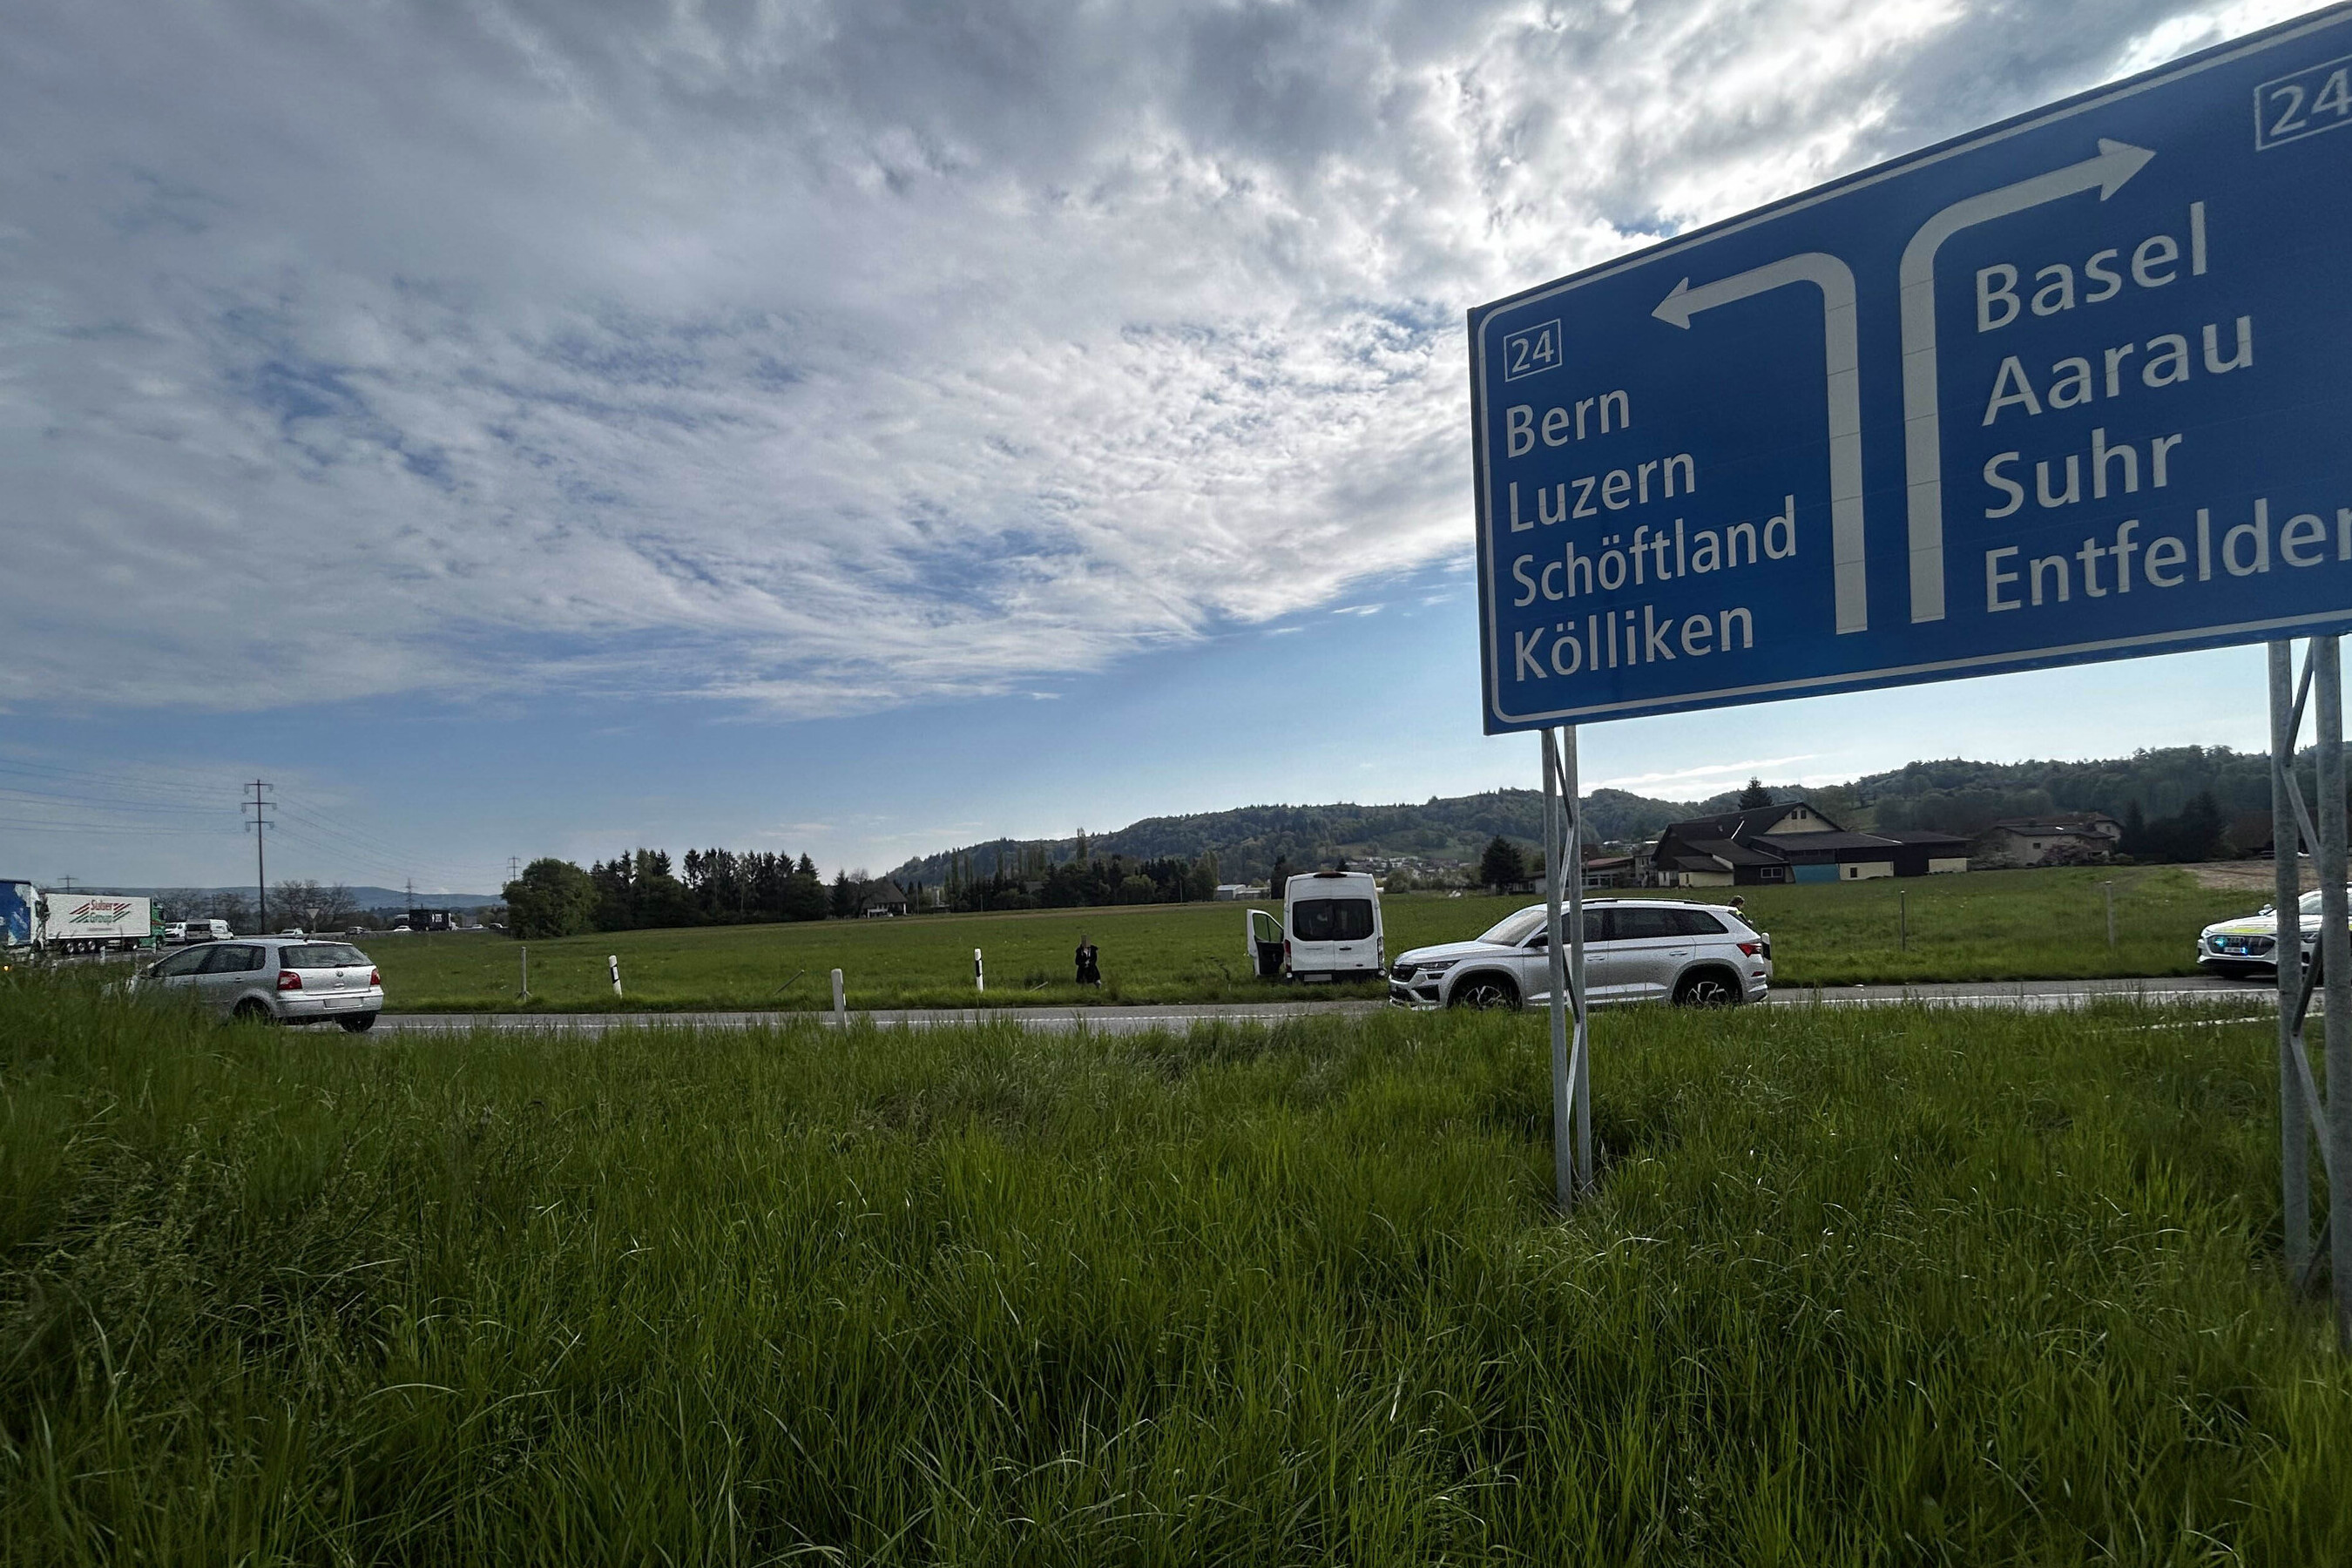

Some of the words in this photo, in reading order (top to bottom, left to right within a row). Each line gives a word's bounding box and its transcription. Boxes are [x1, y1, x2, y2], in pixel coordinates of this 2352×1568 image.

[2270, 68, 2352, 136] 24
[1977, 201, 2207, 333] Basel
[1511, 329, 1555, 374] 24
[1983, 315, 2254, 427] Aarau
[1506, 389, 1631, 458] Bern
[1508, 453, 1696, 532] Luzern
[1984, 428, 2183, 518] Suhr
[1512, 494, 1797, 607] Schöftland
[1515, 605, 1754, 682] Kölliken
